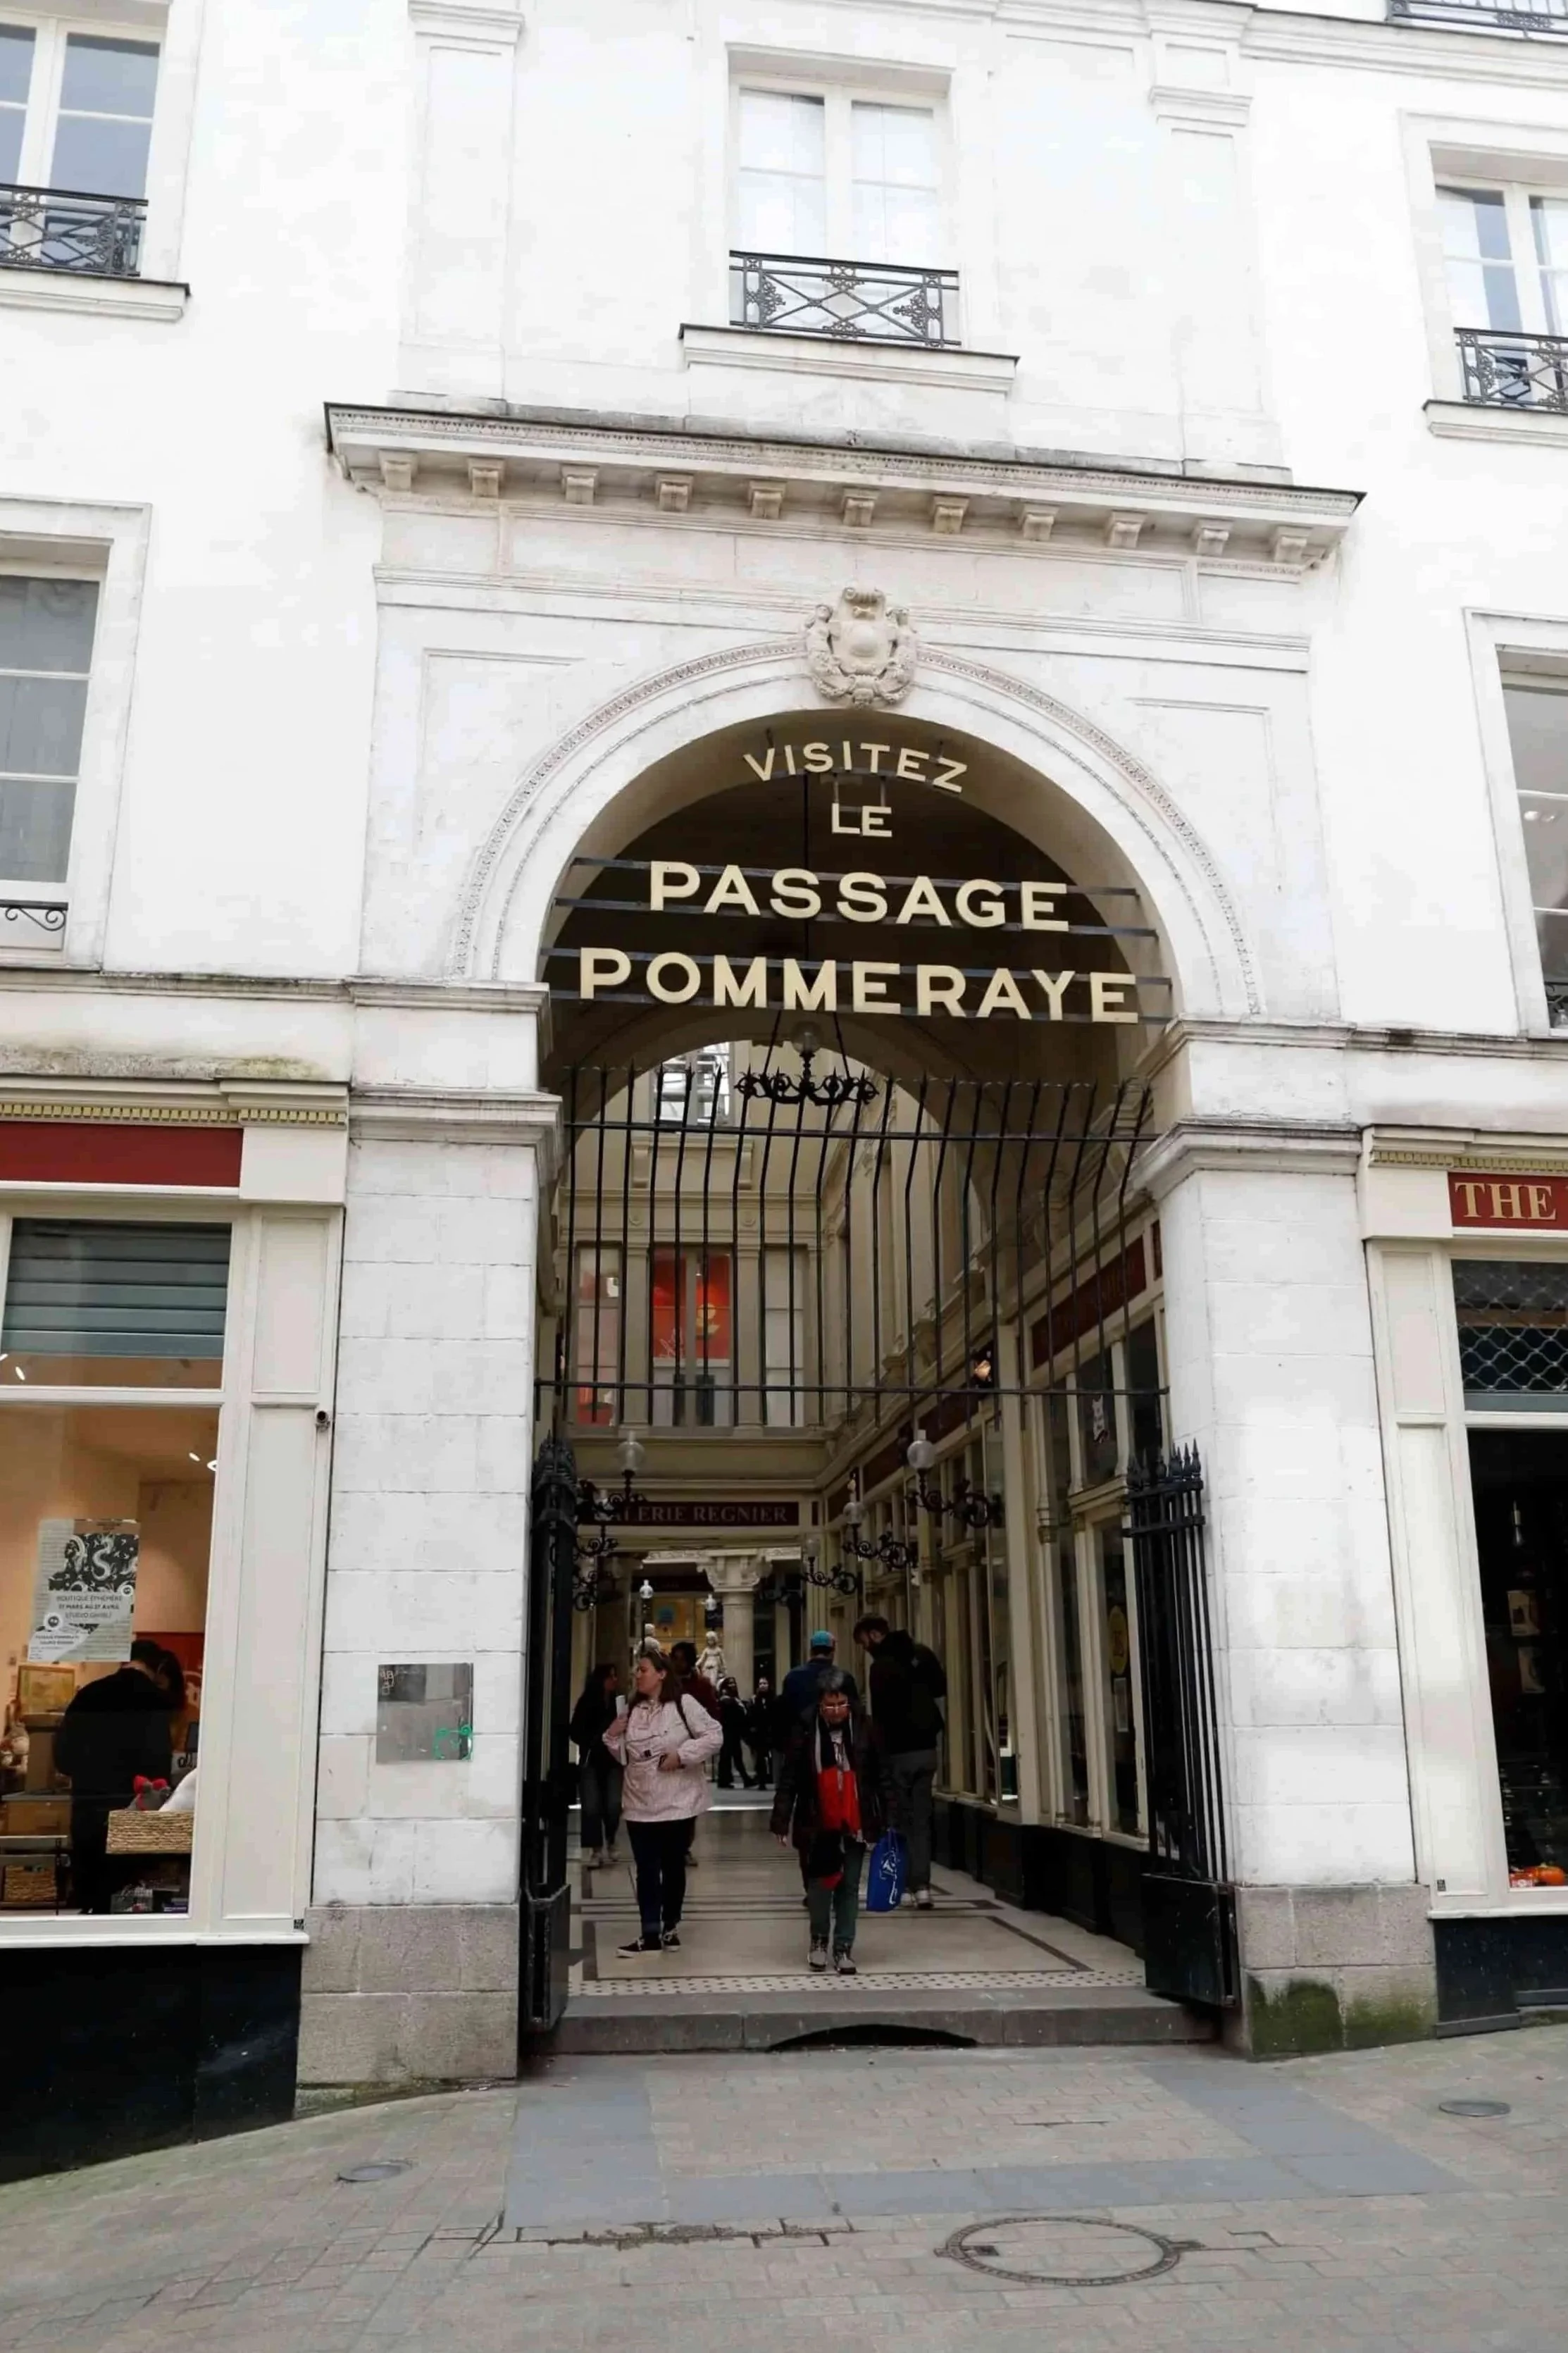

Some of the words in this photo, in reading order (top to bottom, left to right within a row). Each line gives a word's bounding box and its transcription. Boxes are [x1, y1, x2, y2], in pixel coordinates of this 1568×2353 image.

[744, 741, 968, 793] VISITEZ
[831, 803, 892, 838] LE
[649, 860, 1069, 931] PASSAGE
[580, 947, 1138, 1024] POMMERAYE
[1455, 1182, 1556, 1220] THE
[693, 1505, 788, 1522] REGNIER
